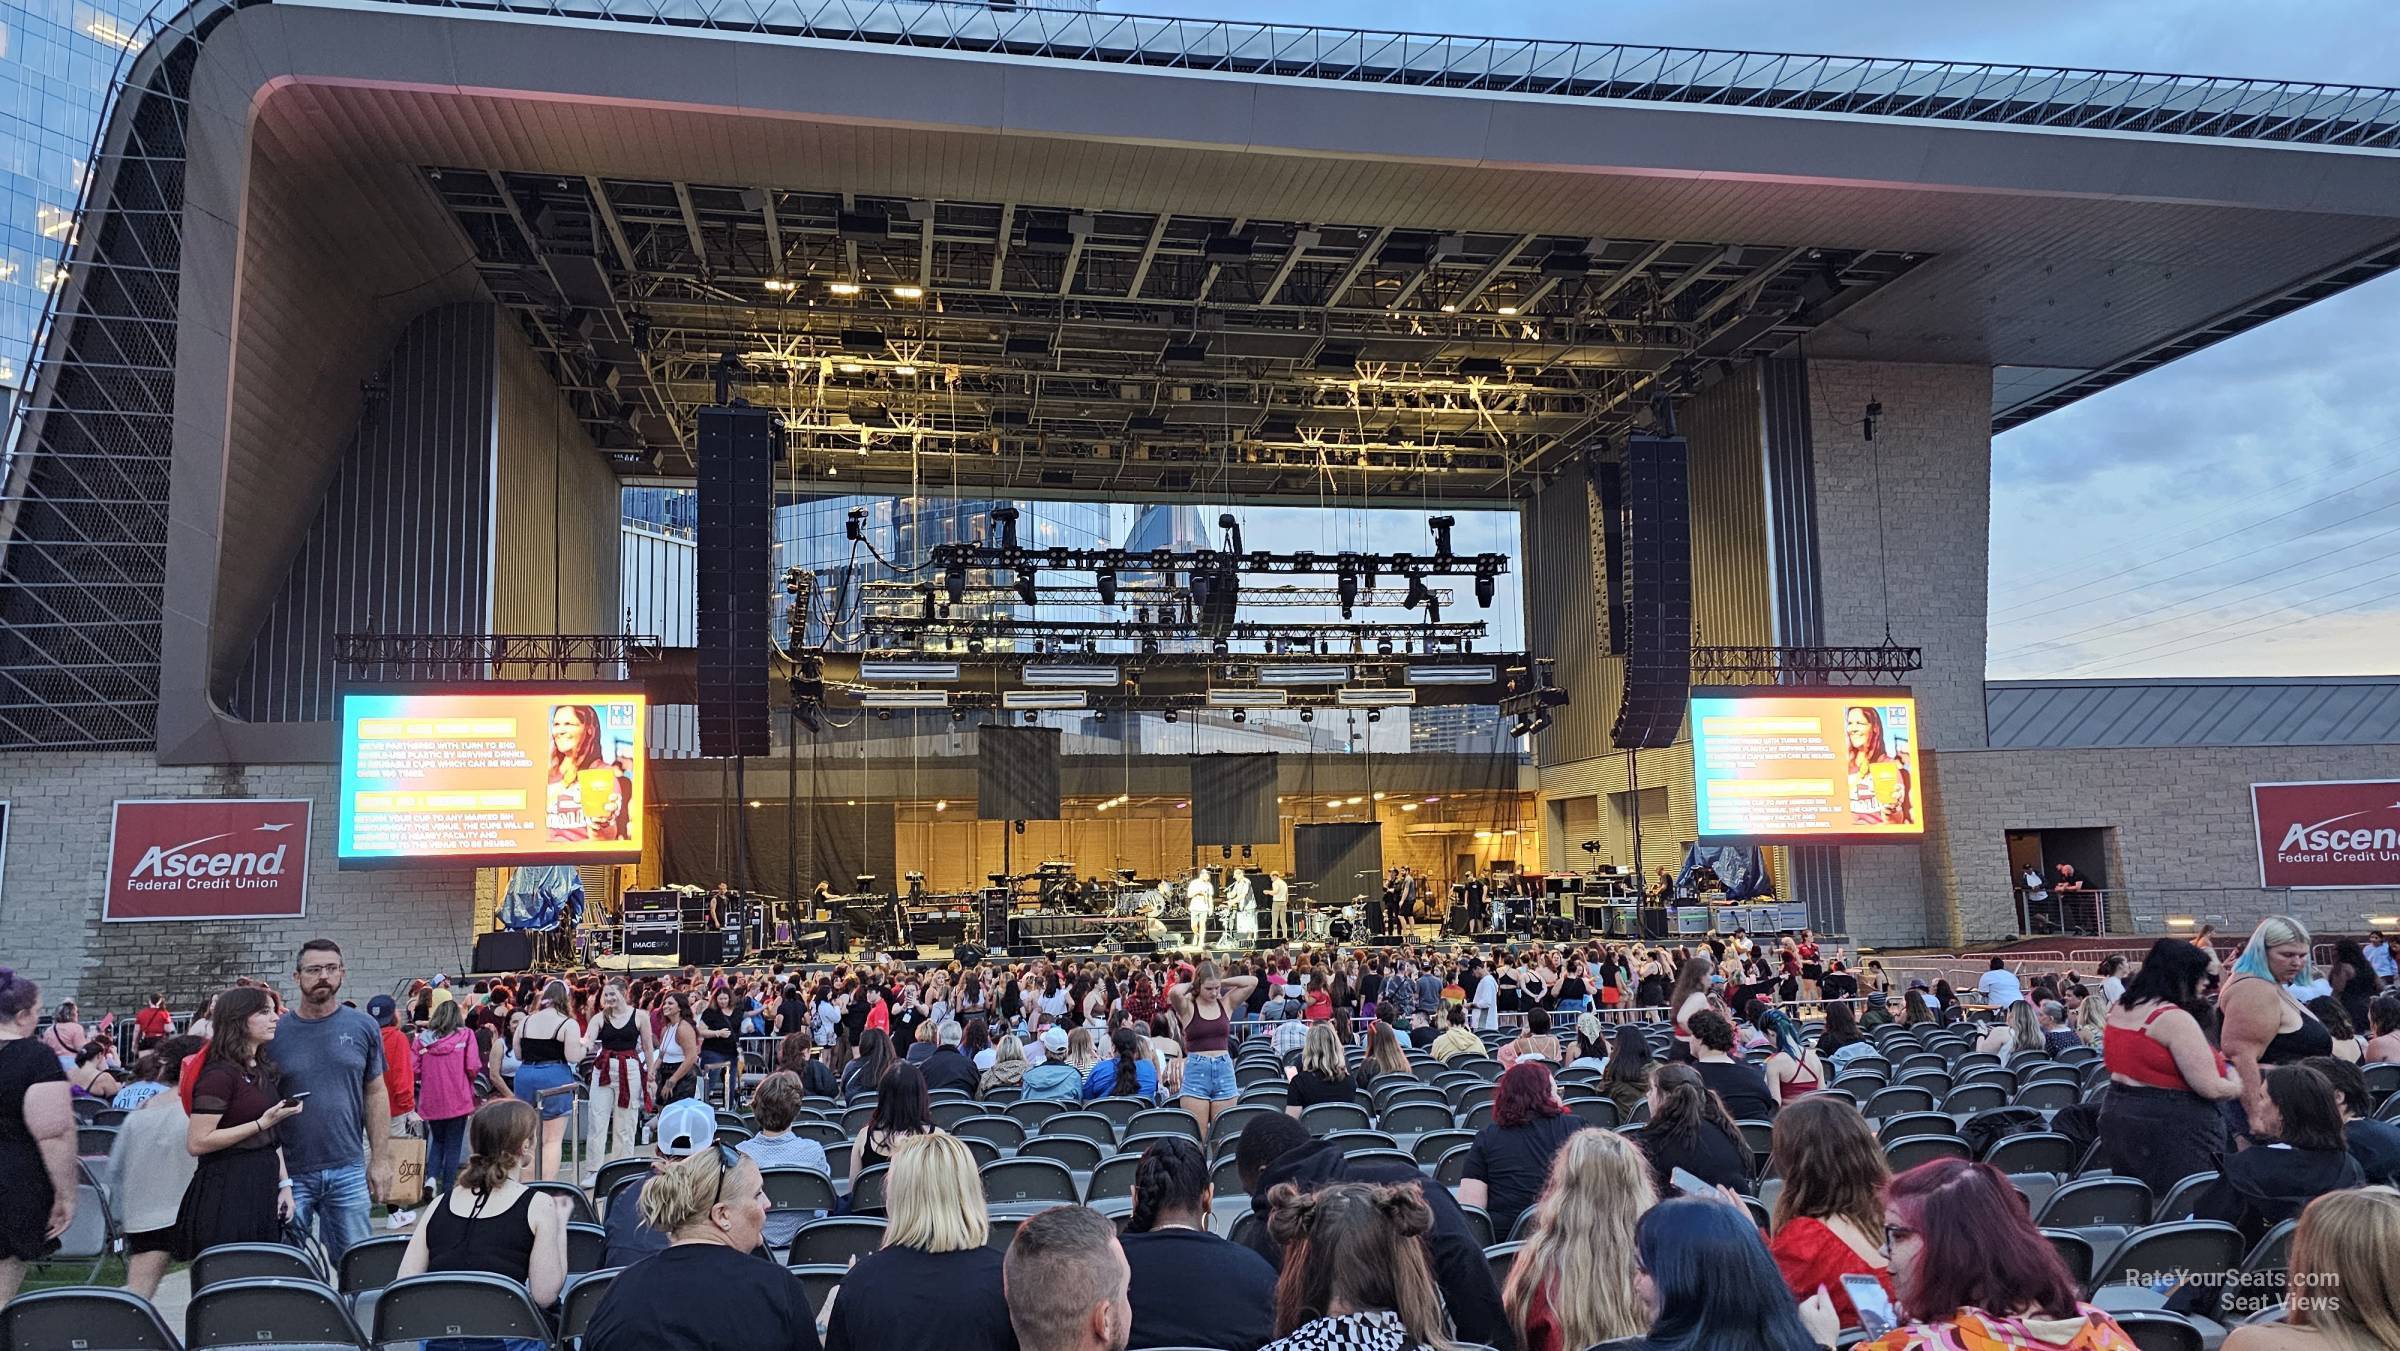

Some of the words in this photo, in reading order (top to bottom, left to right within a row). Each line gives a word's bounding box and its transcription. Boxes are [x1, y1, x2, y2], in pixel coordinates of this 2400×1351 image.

[437, 742, 458, 750] WITH
[461, 742, 483, 750] TURN
[443, 751, 455, 759] BY
[437, 760, 466, 768] WHICH
[390, 814, 412, 822] YOUR
[413, 814, 431, 822] CUP
[432, 814, 444, 822] TO
[445, 814, 463, 822] ANY
[463, 822, 478, 830] THE
[480, 831, 497, 839] AND
[2278, 823, 2400, 851] Ascen
[459, 840, 471, 848] TO
[129, 844, 287, 877] Ascend
[2278, 852, 2328, 863] Federal
[2333, 851, 2375, 862] Credit
[127, 879, 181, 891] Federal
[186, 878, 230, 890] Credit
[235, 877, 278, 889] Union
